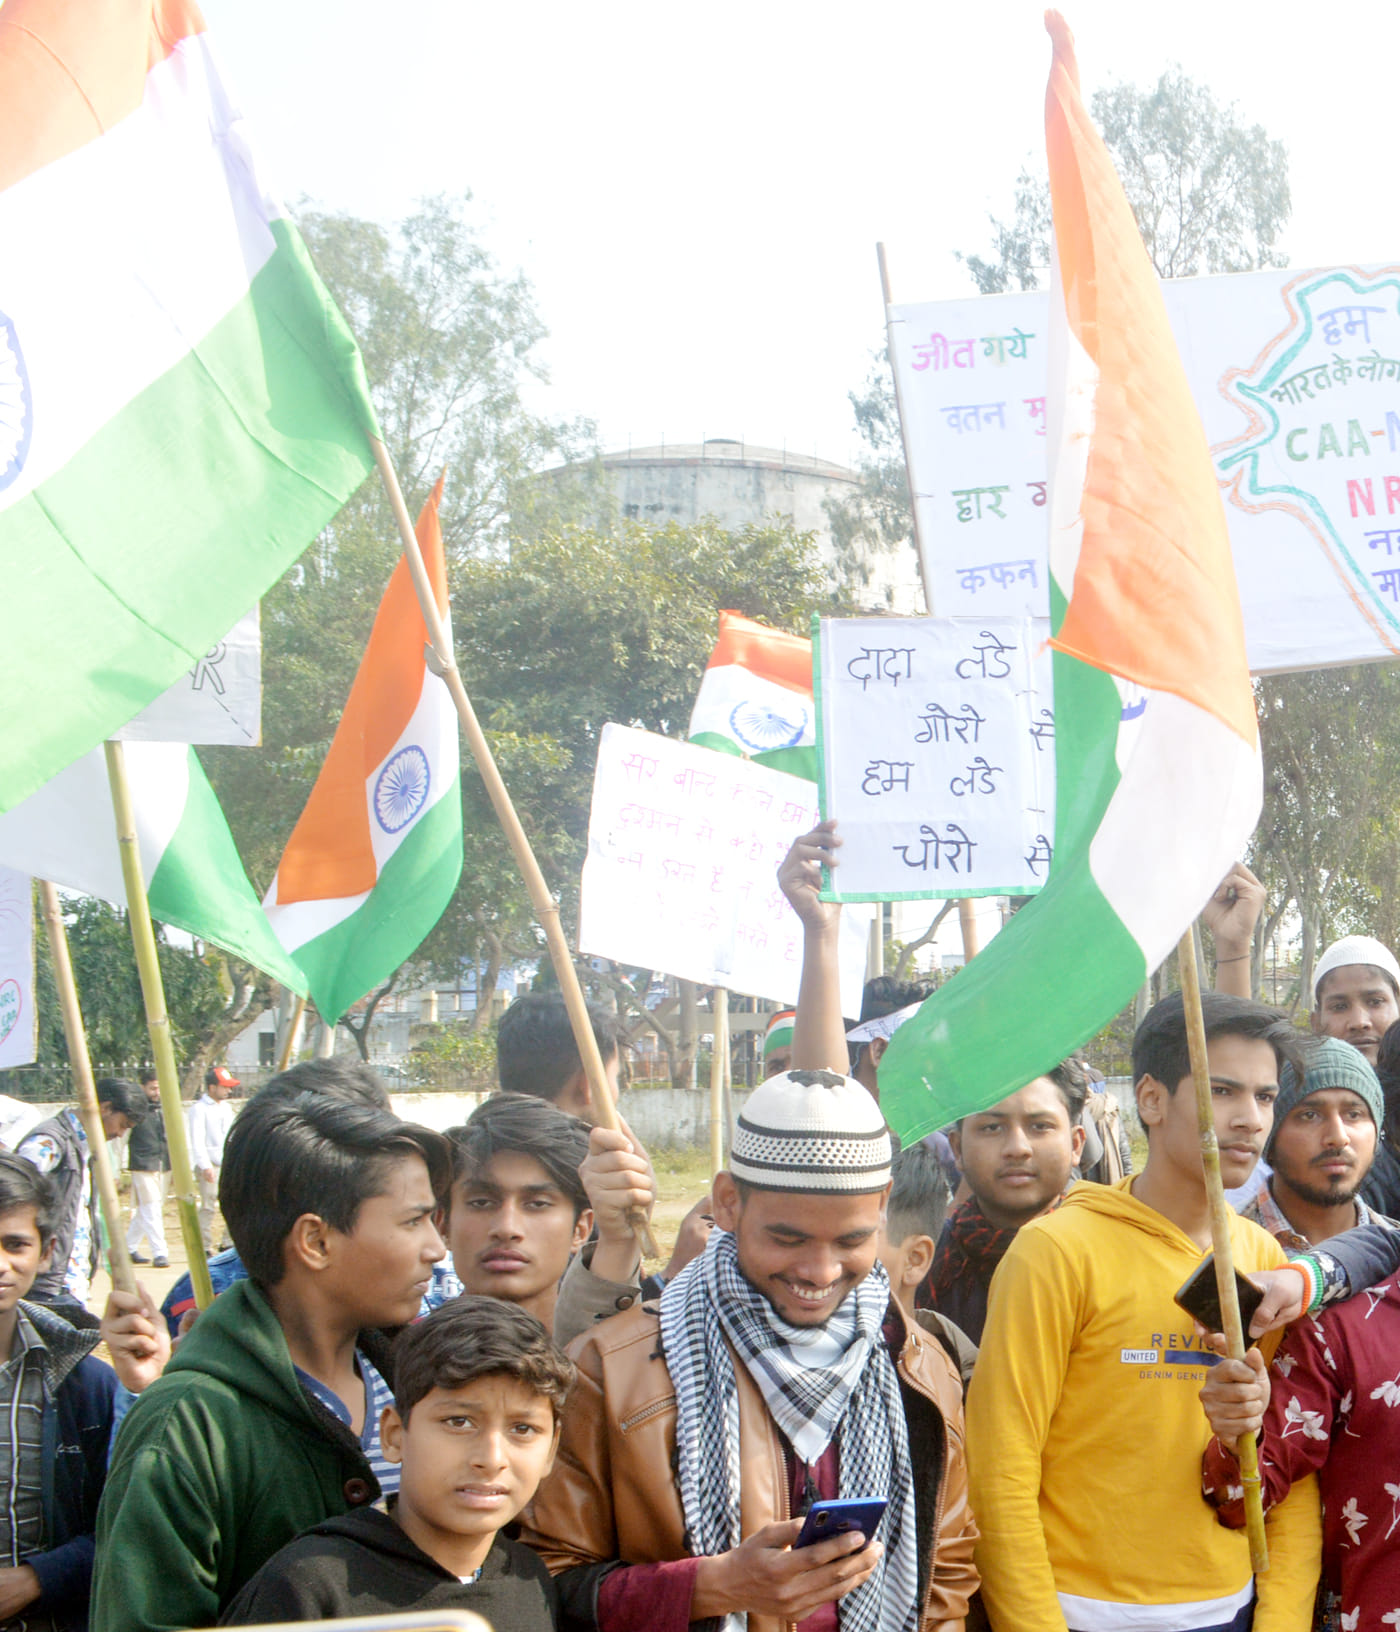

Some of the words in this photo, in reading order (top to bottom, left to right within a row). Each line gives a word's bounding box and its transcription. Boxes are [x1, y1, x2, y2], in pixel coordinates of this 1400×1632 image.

[1317, 305, 1387, 346] हम
[911, 332, 976, 371] जीत
[979, 327, 1036, 363] गये
[1270, 358, 1332, 405] भारत
[1332, 352, 1353, 387] के
[940, 401, 1006, 434] वतन
[952, 485, 1010, 523] हार
[956, 559, 1040, 594] कफन
[848, 647, 916, 691] दादा
[861, 760, 915, 796] हम
[1123, 1352, 1156, 1361] UNITED
[1151, 1333, 1214, 1351] REVI
[1139, 1370, 1173, 1379] DENIM
[1177, 1371, 1205, 1381] GENE
